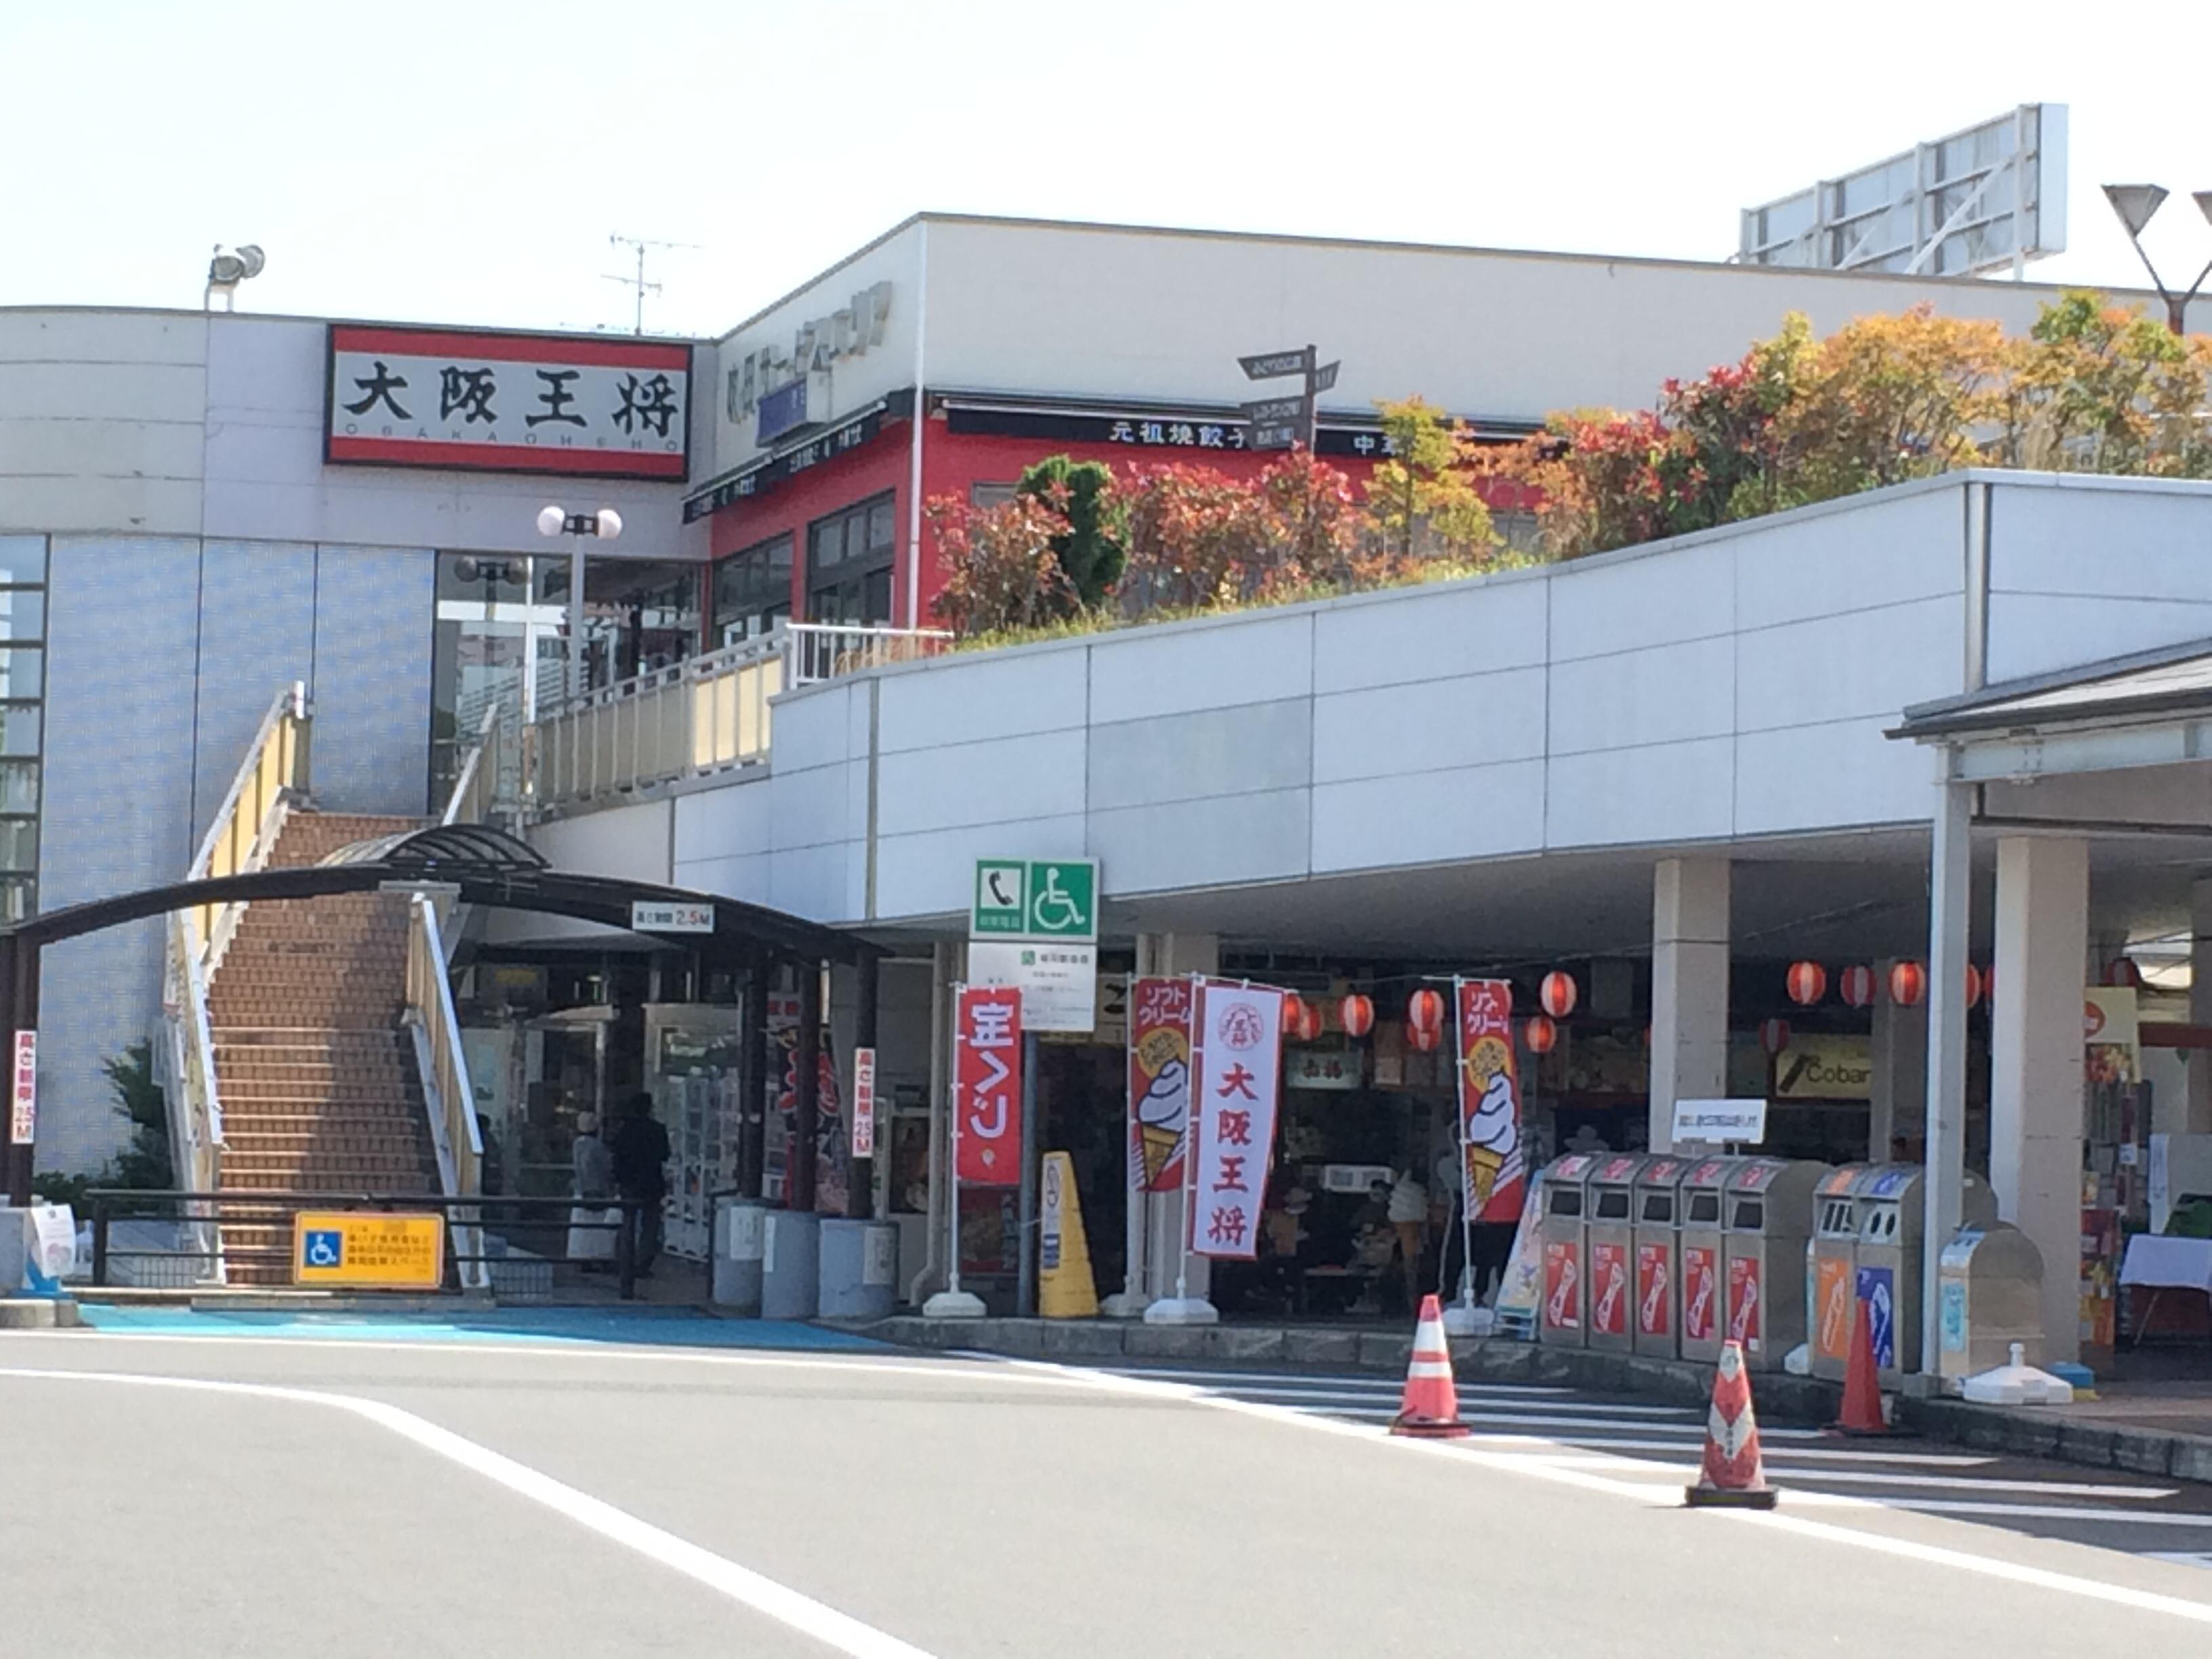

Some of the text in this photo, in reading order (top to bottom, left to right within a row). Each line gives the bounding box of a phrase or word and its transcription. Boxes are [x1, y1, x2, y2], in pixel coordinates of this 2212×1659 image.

[342, 361, 678, 438] 大阪王将
[1147, 986, 1186, 1006] ソフト
[1207, 1062, 1258, 1246] 大阪王将
